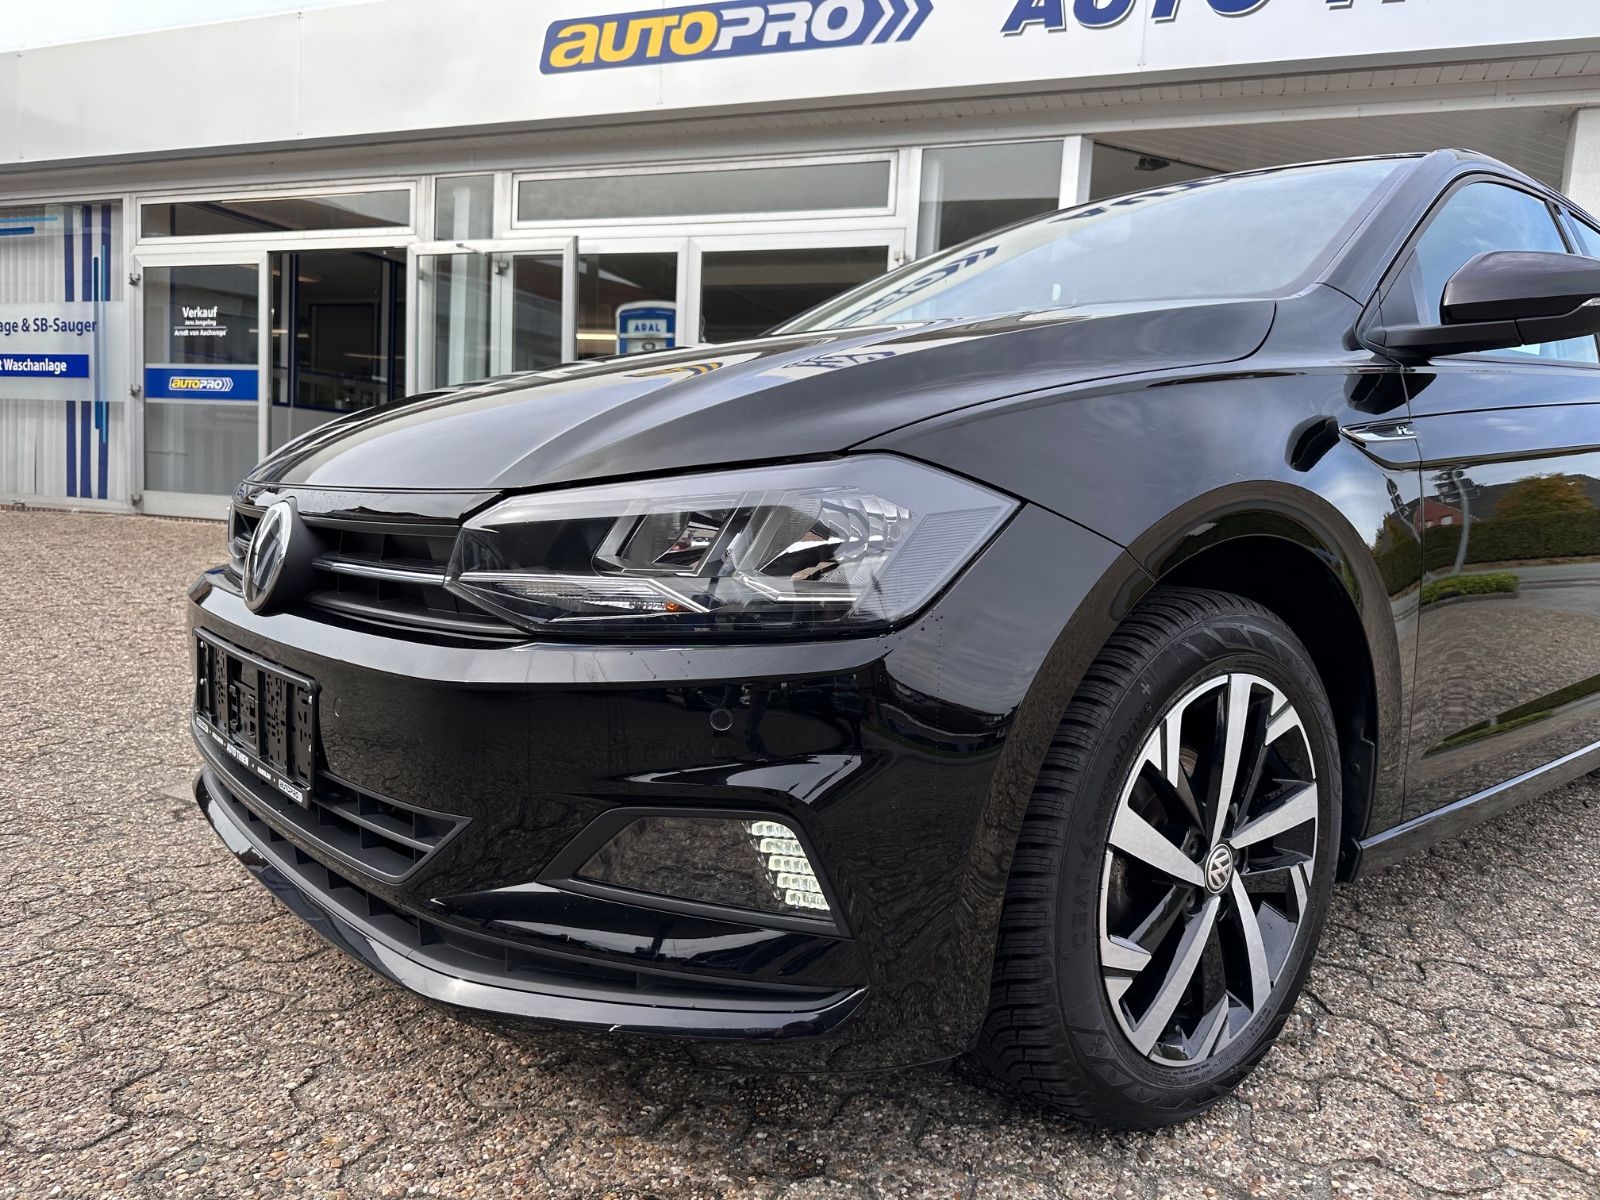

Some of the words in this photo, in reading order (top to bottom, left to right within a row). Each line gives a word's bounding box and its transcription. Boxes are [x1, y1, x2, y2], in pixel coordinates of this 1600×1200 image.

[182, 305, 218, 318] Verkauf
[21, 318, 31, 332] &
[33, 317, 97, 336] SB-Sauger
[634, 322, 660, 333] ARAL
[3, 358, 67, 374] Waschanlage
